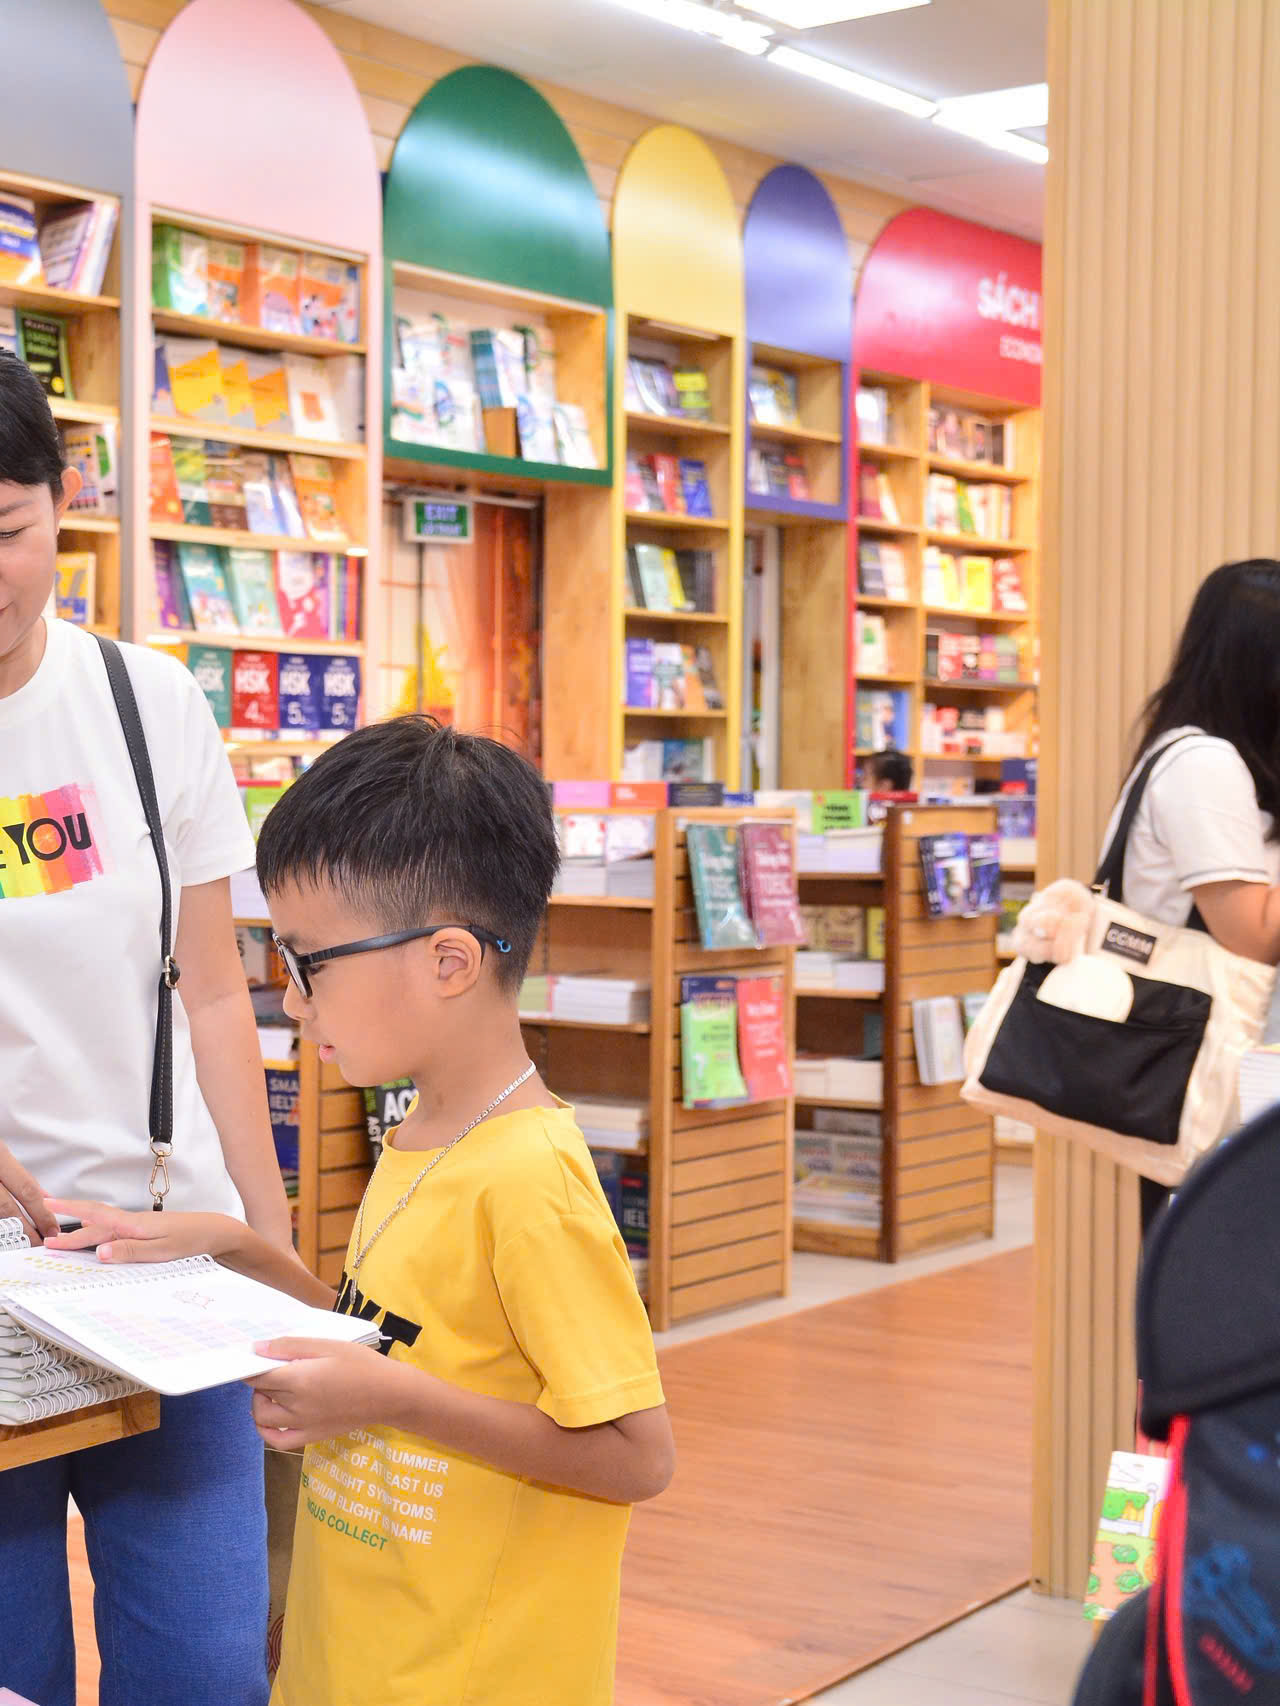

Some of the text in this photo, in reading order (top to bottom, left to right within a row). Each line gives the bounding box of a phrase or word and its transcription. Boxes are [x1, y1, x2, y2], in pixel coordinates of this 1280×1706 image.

[977, 270, 1039, 328] SÁCH
[234, 668, 271, 695] HSK
[279, 670, 311, 696] HSK
[323, 671, 356, 697] HSK
[2, 812, 92, 866] YOU
[383, 1089, 418, 1123] AC
[351, 1452, 369, 1469] OF
[423, 1481, 445, 1499] US
[385, 1447, 449, 1476] SUMMER
[329, 1464, 366, 1494] BLIGHT
[327, 1514, 389, 1551] COLLECT
[336, 1495, 382, 1525] BLIGHT
[391, 1519, 434, 1546] NAME
